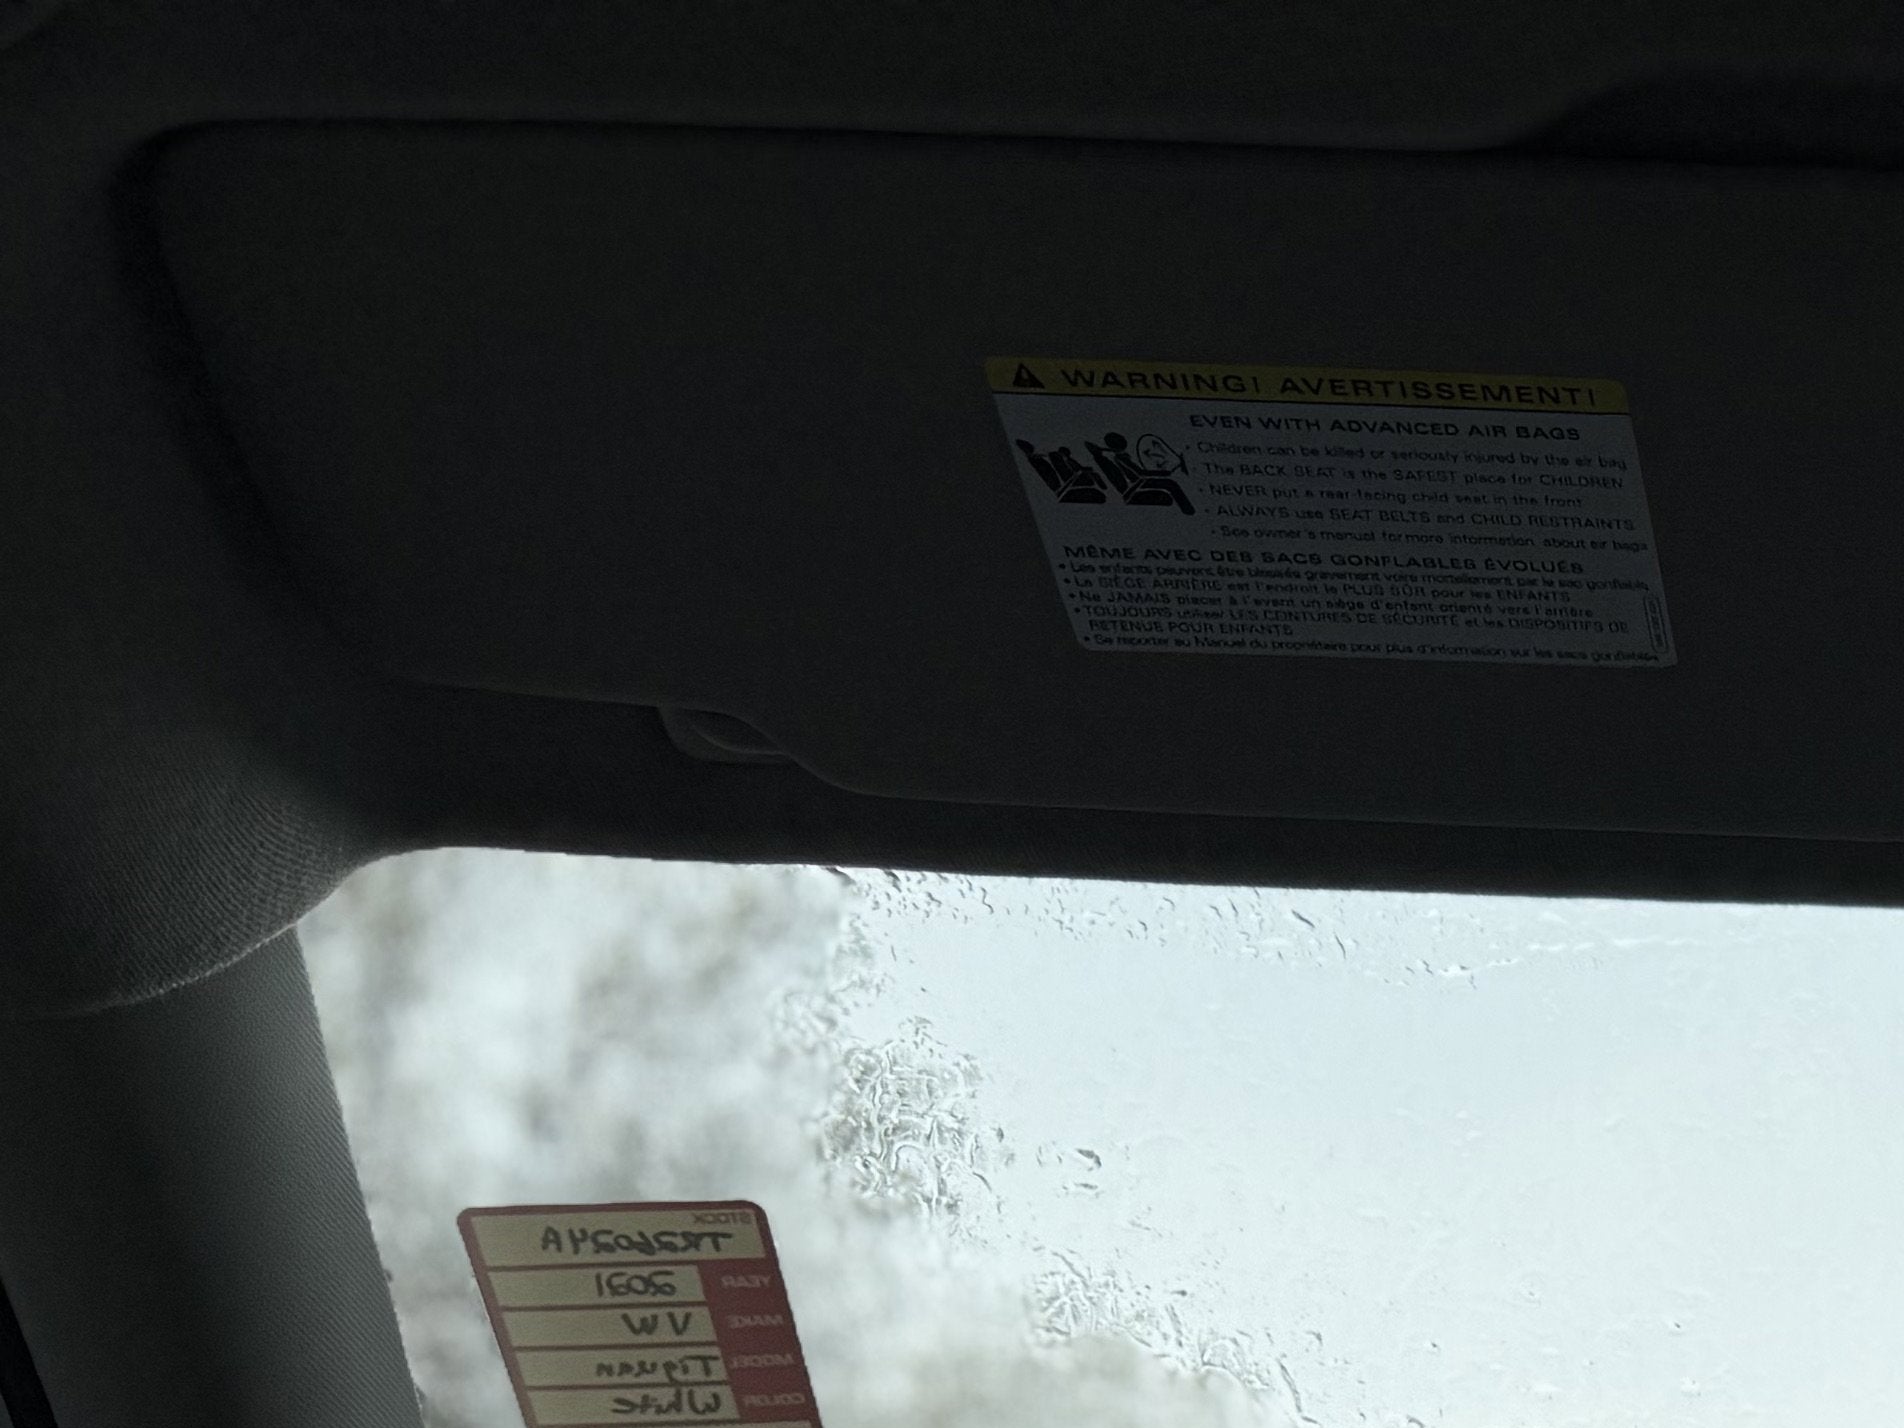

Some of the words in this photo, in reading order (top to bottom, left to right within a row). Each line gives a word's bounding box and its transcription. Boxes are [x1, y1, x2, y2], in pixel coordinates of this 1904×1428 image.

[1061, 368, 1261, 395] WARNING!
[1280, 376, 1597, 407] AVERTISSEMENT!
[1188, 413, 1252, 429] EVEN
[1257, 416, 1322, 431] WITH
[1327, 418, 1460, 436] ADVANCED
[1466, 423, 1508, 437] AIR
[1514, 425, 1581, 440] BAGS
[1208, 484, 1267, 496] NEVER
[1062, 544, 1136, 560] MÊME
[1141, 547, 1204, 562] AVEC
